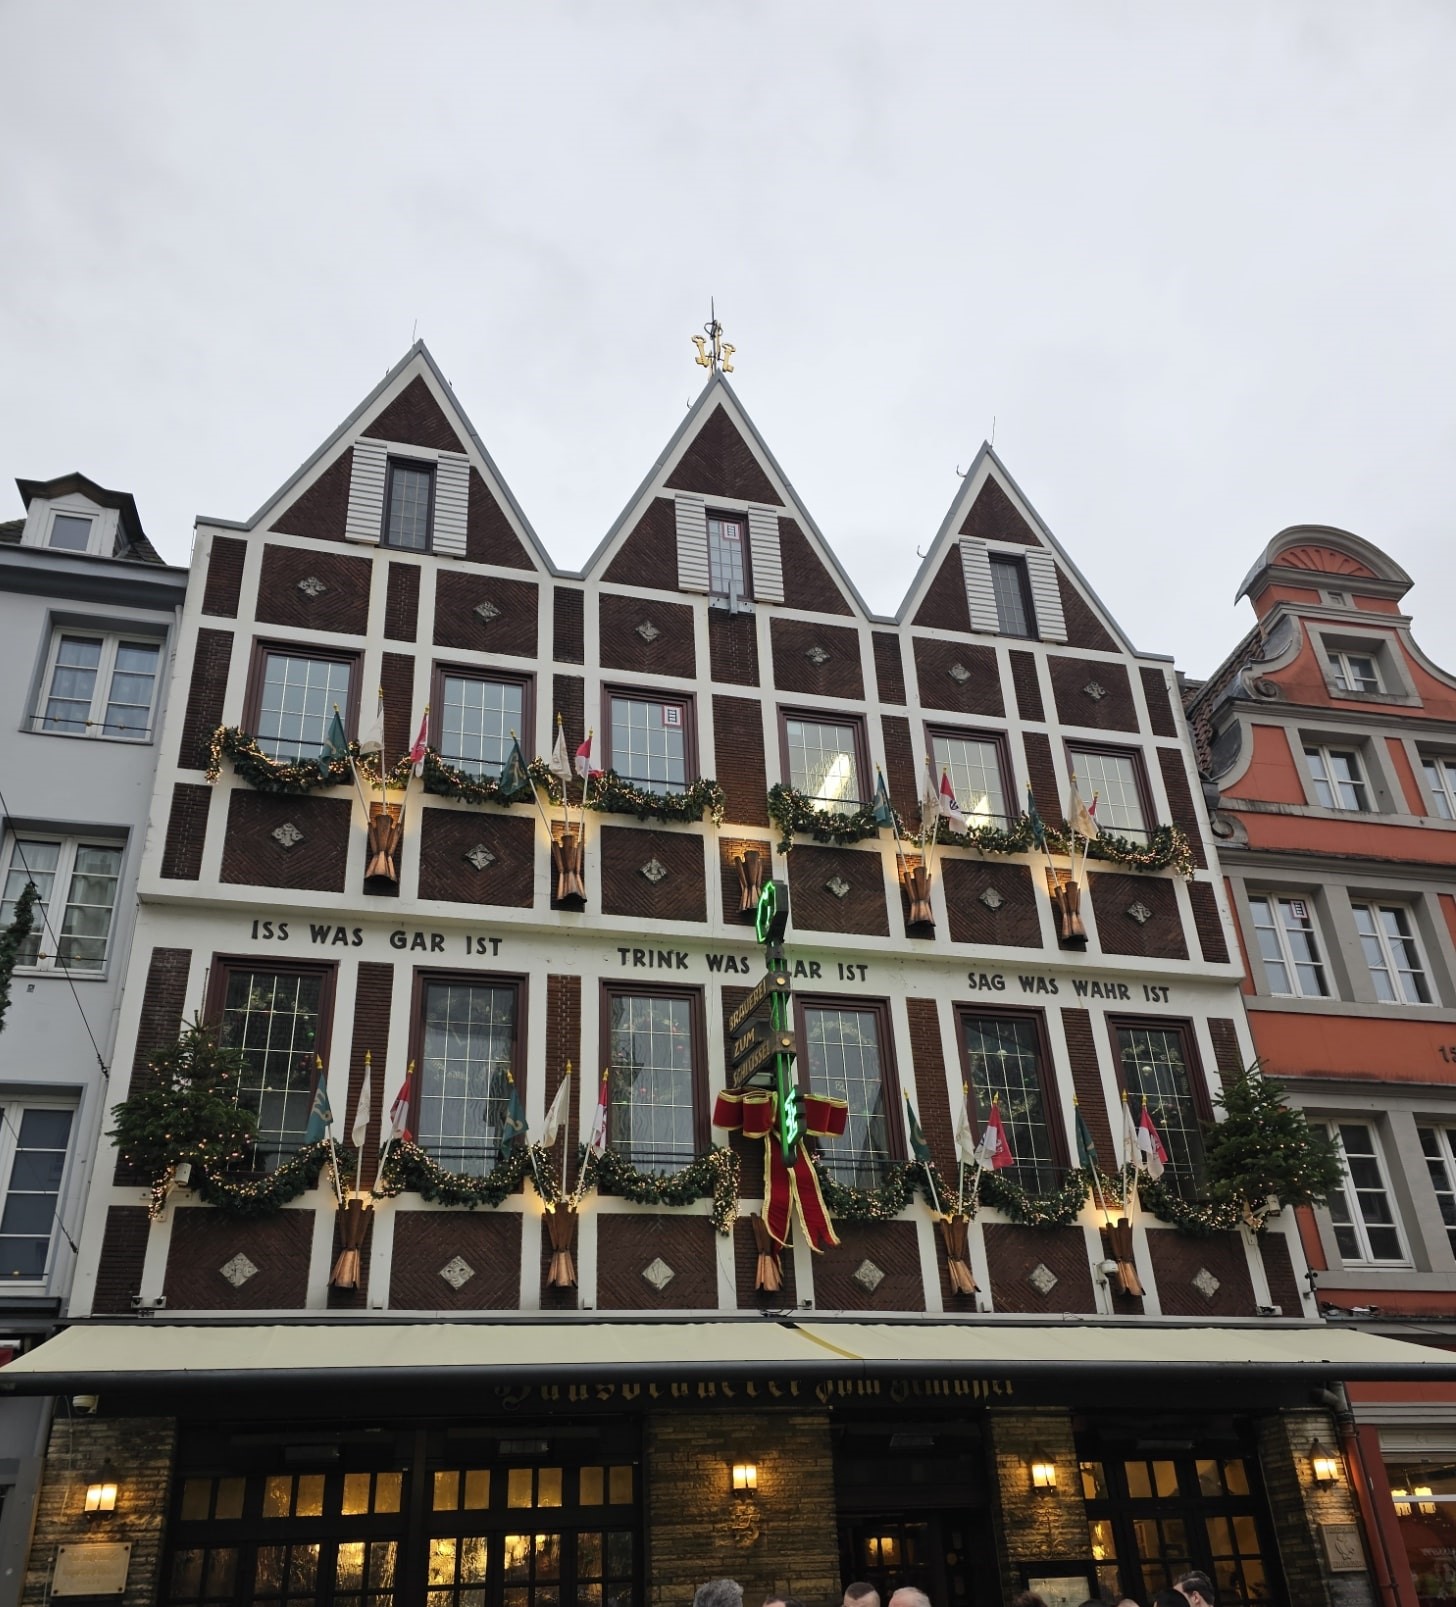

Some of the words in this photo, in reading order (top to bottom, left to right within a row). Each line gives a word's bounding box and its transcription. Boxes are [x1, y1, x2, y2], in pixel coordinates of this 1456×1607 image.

[251, 920, 289, 941] ISS
[309, 925, 363, 947] WAS
[390, 930, 445, 952] GAR
[466, 936, 503, 956] IST
[617, 948, 688, 969] TRINK
[705, 953, 750, 974] WAS
[837, 962, 869, 982] IST
[968, 971, 1006, 992] SAG
[1018, 975, 1059, 996] WAS
[1072, 979, 1131, 1002] WAHR
[1142, 984, 1170, 1005] IST
[729, 980, 766, 1031] BRAUEREI
[733, 1025, 756, 1058] ZUM
